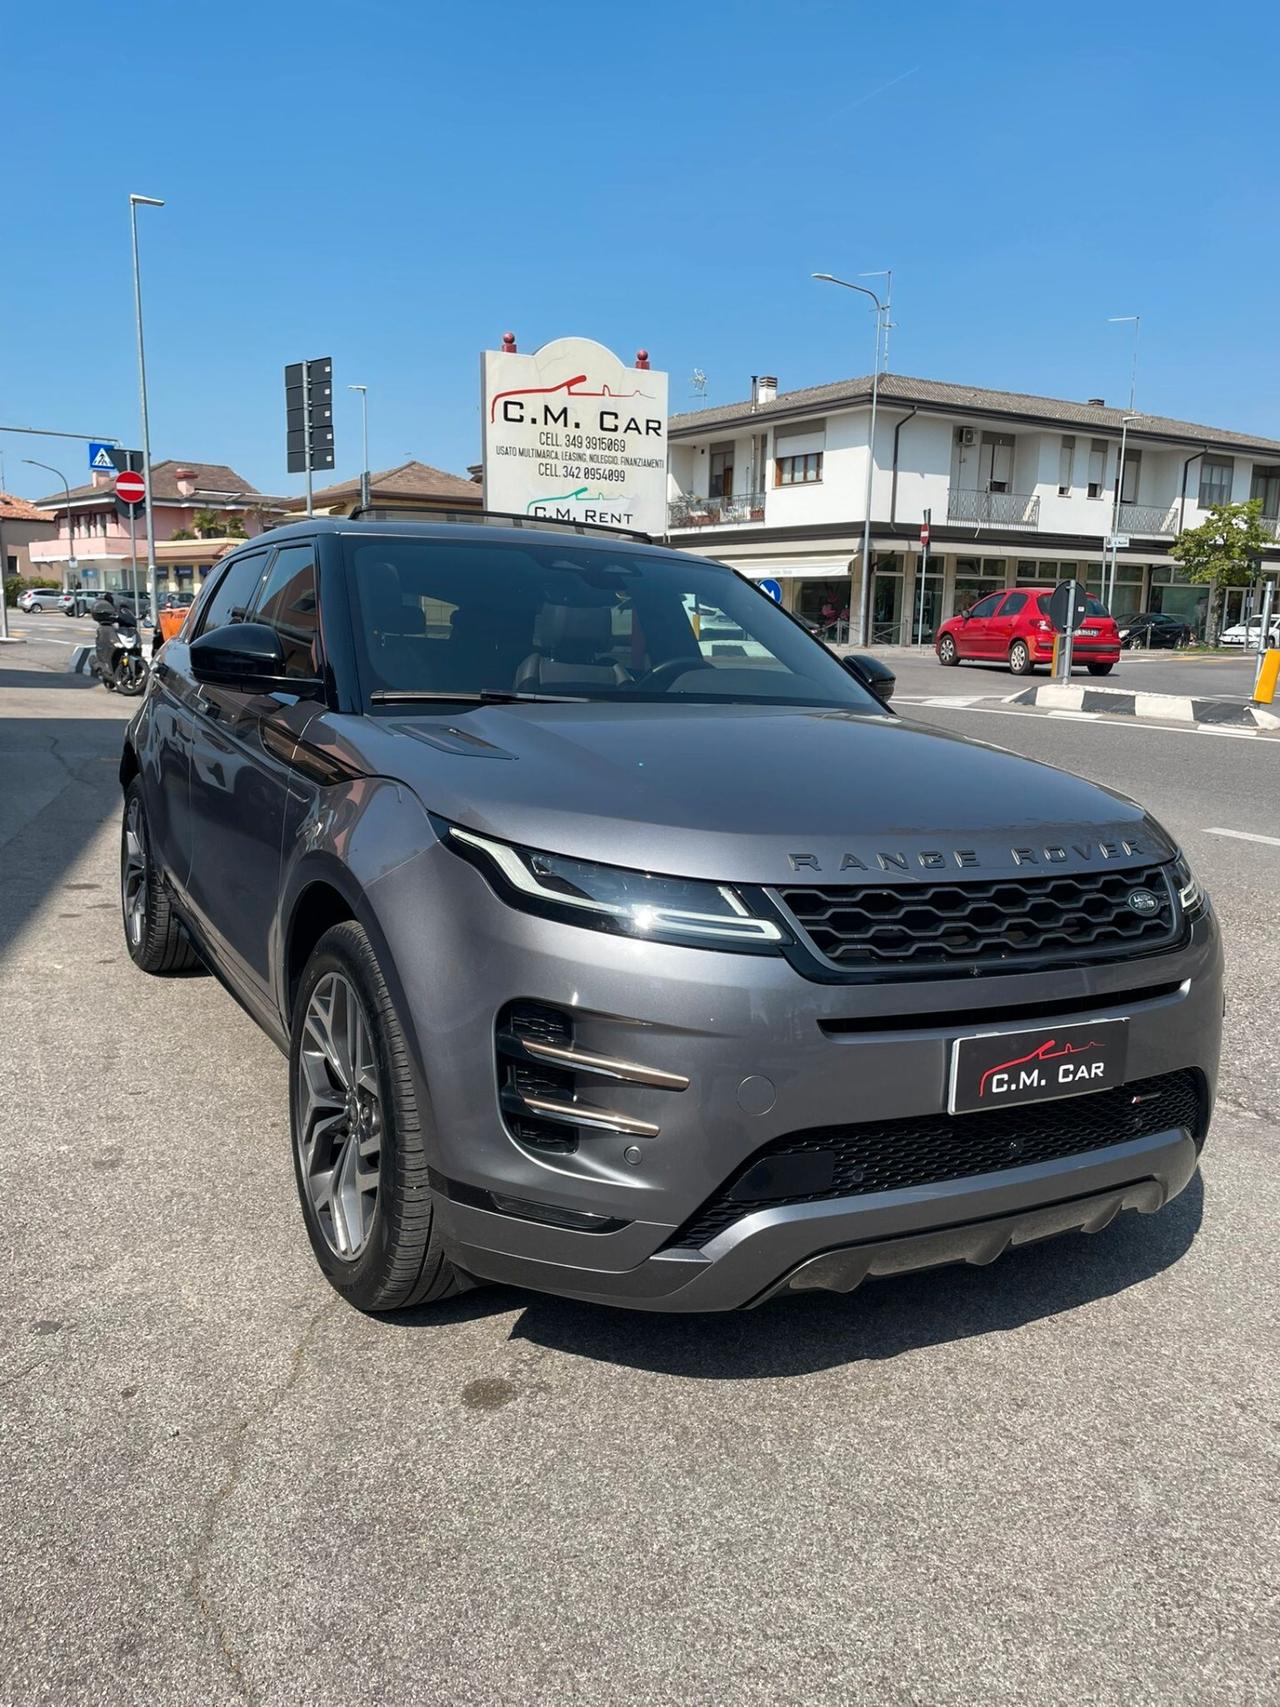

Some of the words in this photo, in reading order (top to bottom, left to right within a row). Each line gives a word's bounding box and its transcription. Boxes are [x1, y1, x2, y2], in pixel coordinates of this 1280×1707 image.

[503, 400, 580, 429] C.M.
[599, 410, 662, 437] CAR
[539, 431, 562, 447] CELL.
[564, 433, 583, 449] 349
[585, 435, 626, 453] 3915069
[496, 445, 517, 457] USATO
[620, 456, 665, 469] FINANZIAMENTI
[538, 462, 561, 478] CELL.
[562, 465, 582, 479] 342
[583, 467, 626, 482] 0954099
[585, 509, 633, 524] RENT
[787, 849, 981, 872] RANGE
[1010, 840, 1144, 865] ROVER
[991, 1068, 1046, 1093] C.M.
[1058, 1062, 1105, 1083] CAR
